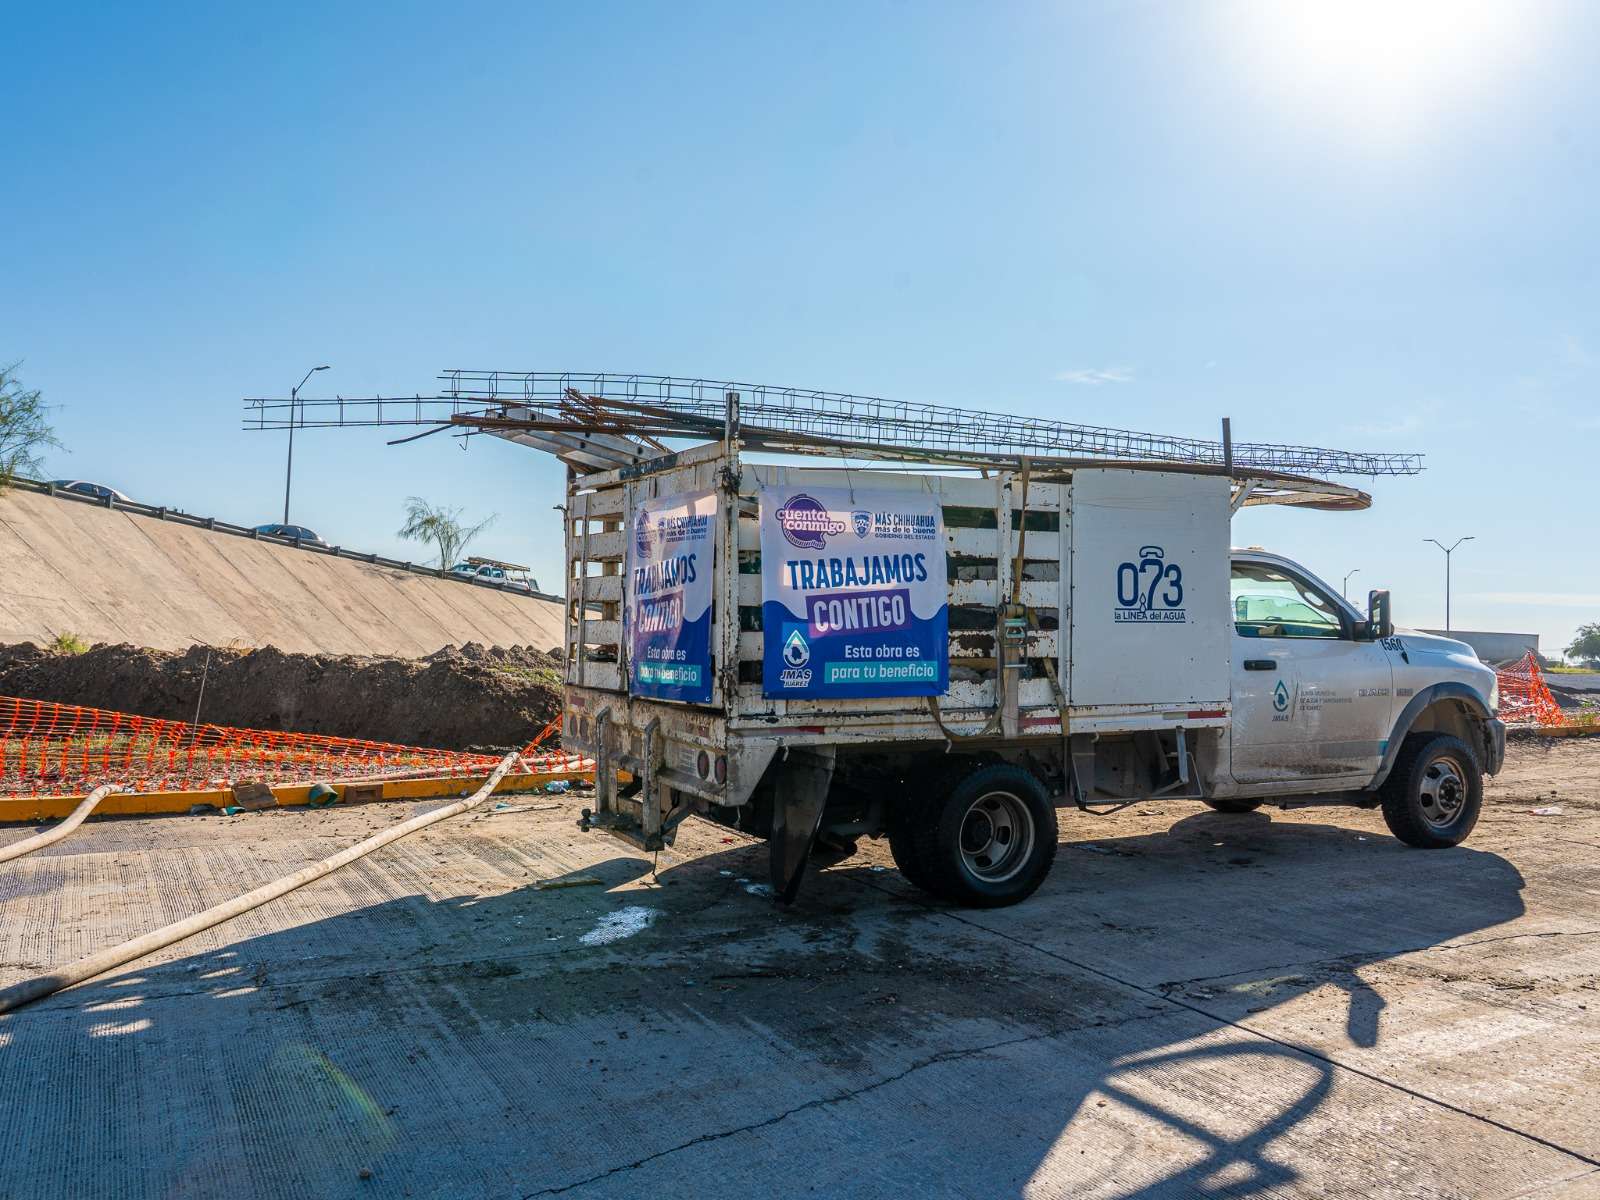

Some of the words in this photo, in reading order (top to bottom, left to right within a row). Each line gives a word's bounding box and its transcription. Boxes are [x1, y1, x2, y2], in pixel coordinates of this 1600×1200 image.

[777, 508, 829, 522] cuenta
[875, 512, 891, 526] MÁS
[893, 513, 935, 528] CHIHUAHUA
[786, 518, 846, 534] conmigo
[787, 553, 928, 590] TRABAJAMOS
[638, 597, 681, 633] CONTIGO
[813, 594, 906, 632] CONTIGO
[1115, 612, 1122, 620] la
[1150, 612, 1161, 620] del
[1163, 612, 1186, 620] AGUA
[845, 645, 872, 658] Esta
[875, 644, 903, 658] obra
[906, 647, 920, 658] es
[1379, 638, 1404, 651] 1560
[647, 646, 660, 659] Esta
[661, 646, 675, 660] obra
[676, 649, 687, 661] es
[662, 667, 697, 682] beneficio
[780, 669, 812, 680] JMAS
[831, 666, 860, 680] para
[864, 665, 877, 678] tu
[880, 664, 934, 678] beneficio
